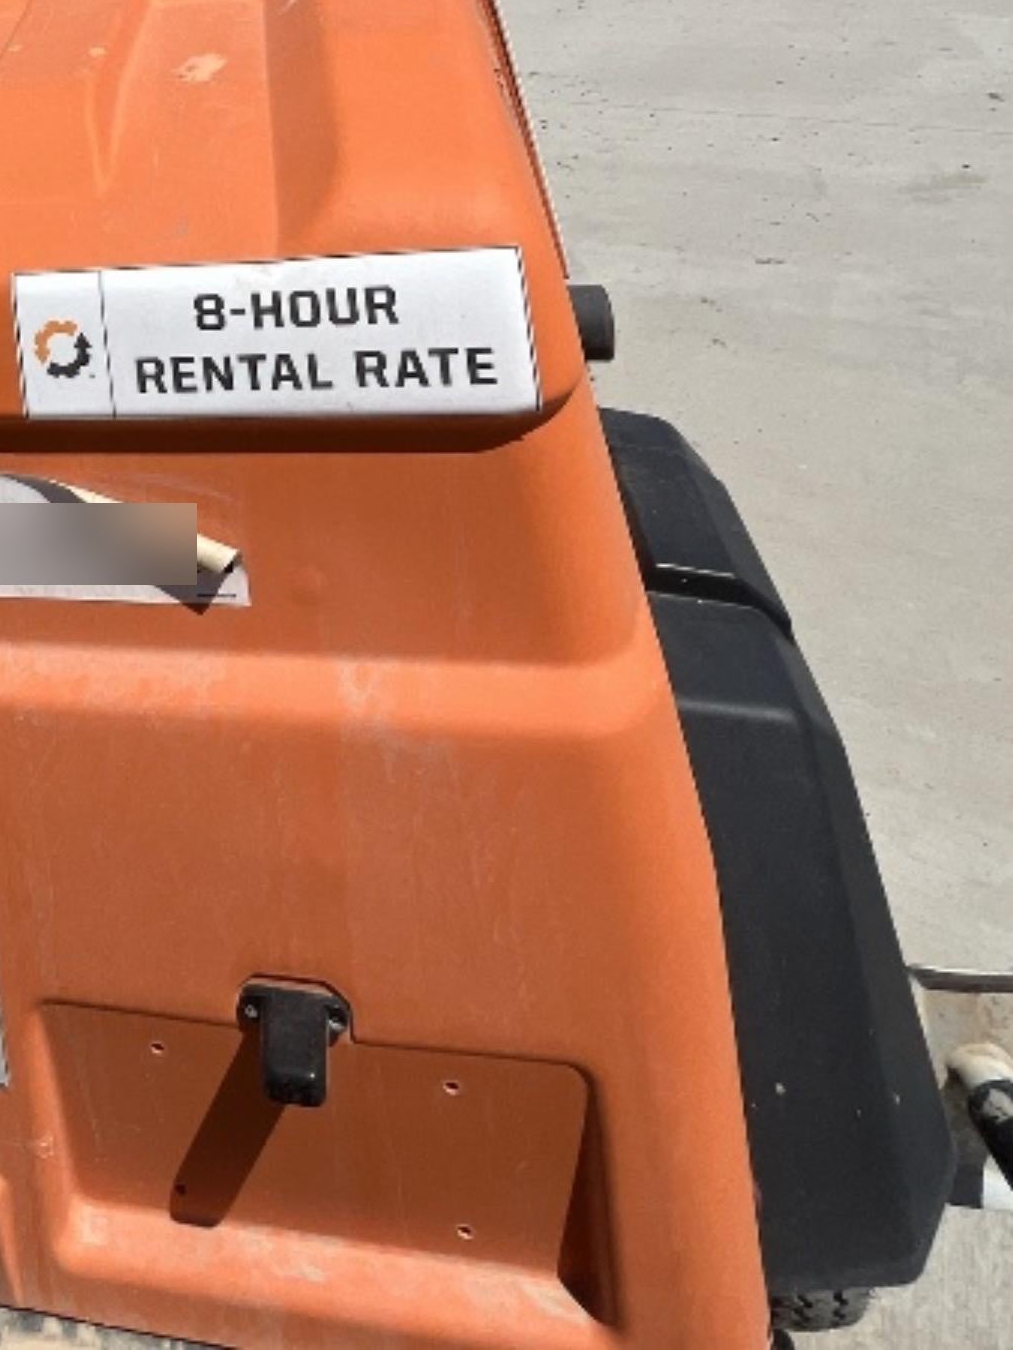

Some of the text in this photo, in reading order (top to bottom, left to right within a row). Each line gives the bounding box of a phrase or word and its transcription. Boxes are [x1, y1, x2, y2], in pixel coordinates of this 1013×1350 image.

[192, 286, 400, 330] 8-HOUR
[135, 347, 499, 395] RENTAL RATE
